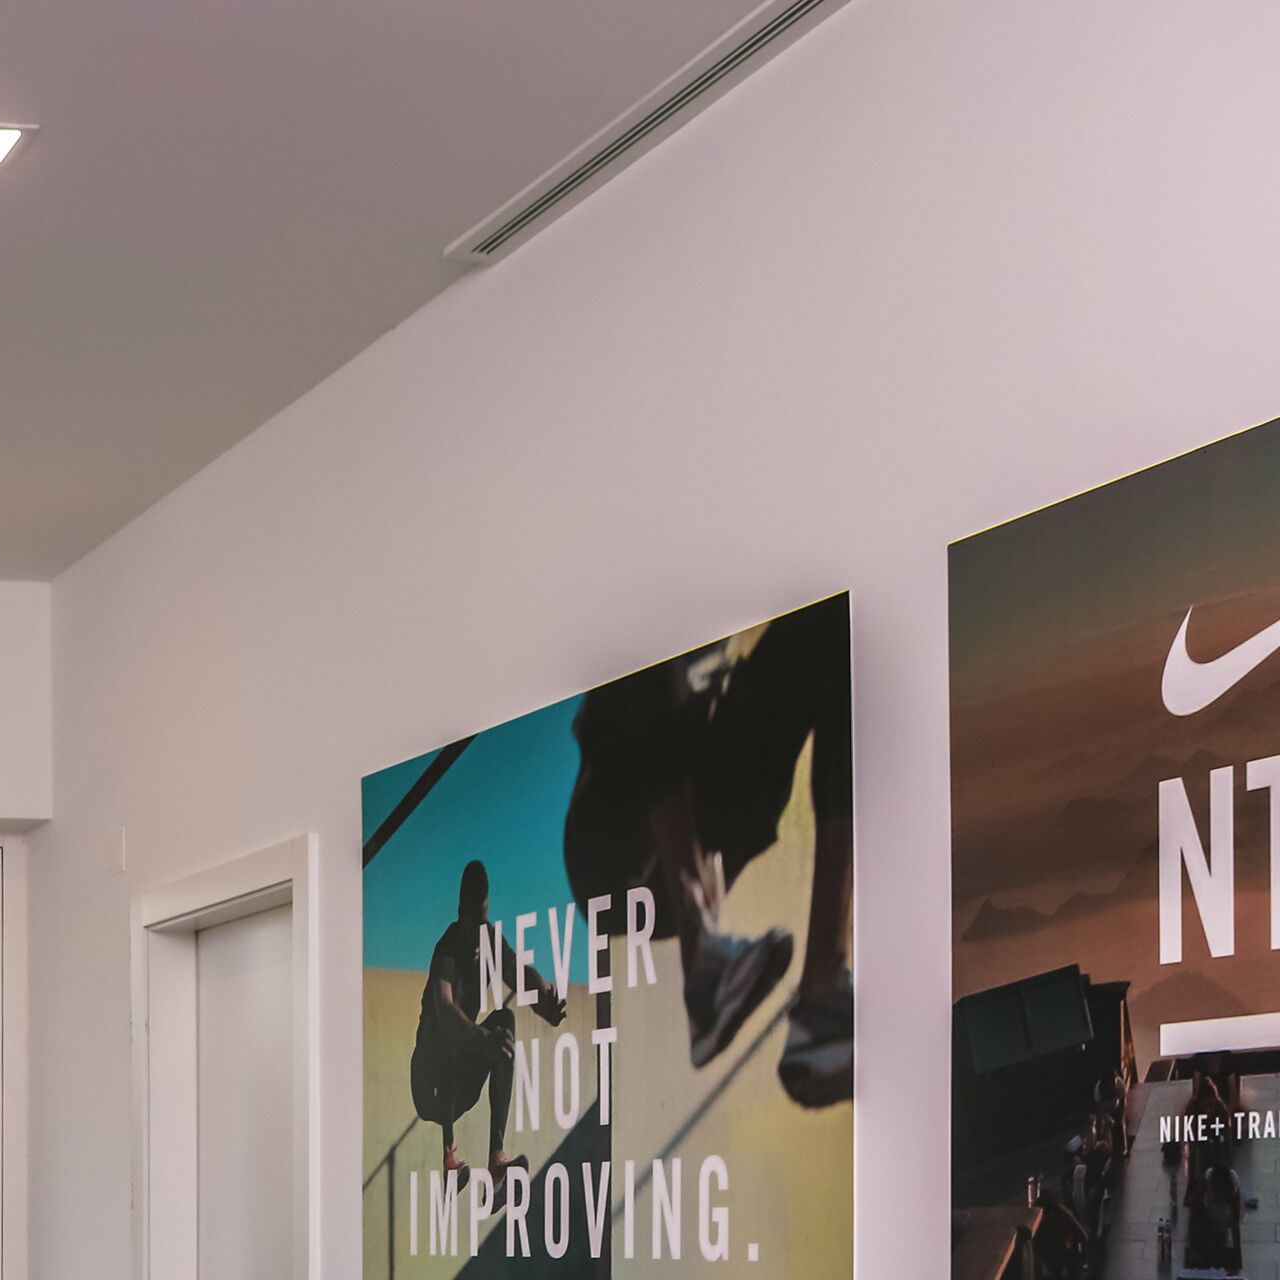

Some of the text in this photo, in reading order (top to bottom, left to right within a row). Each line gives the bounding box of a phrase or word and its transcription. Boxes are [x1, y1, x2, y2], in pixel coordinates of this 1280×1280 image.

[479, 886, 657, 1013] NEVER
[515, 1027, 617, 1132] NOT
[1159, 1114, 1225, 1143] NIKE+
[409, 1154, 759, 1262] IMPROVING.
